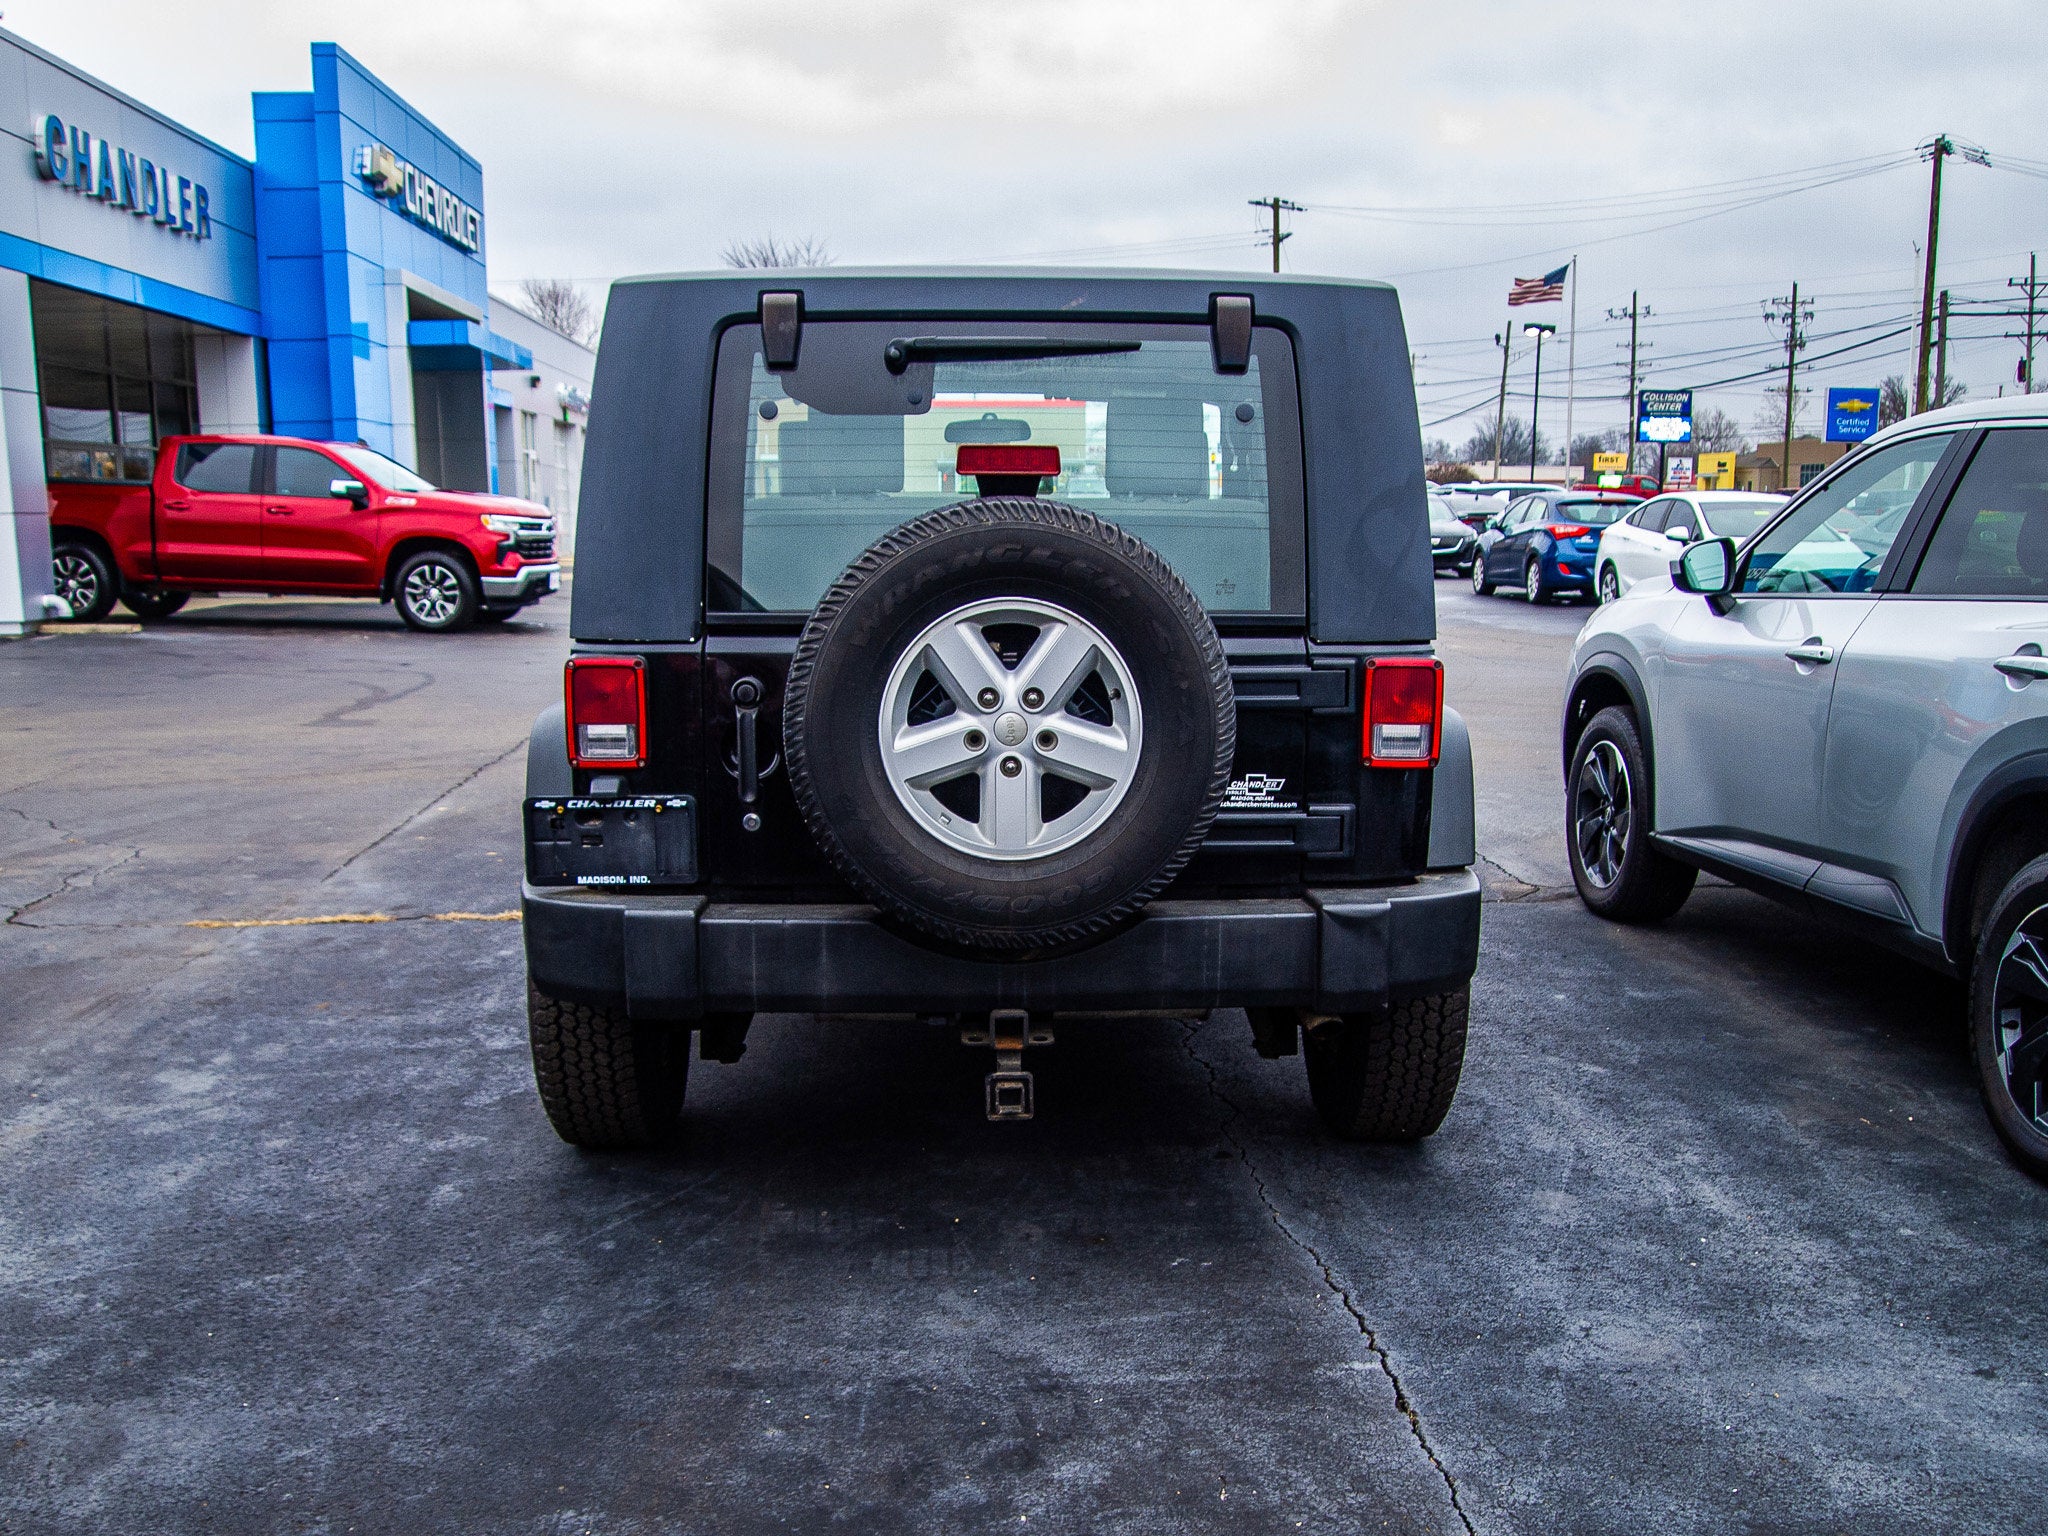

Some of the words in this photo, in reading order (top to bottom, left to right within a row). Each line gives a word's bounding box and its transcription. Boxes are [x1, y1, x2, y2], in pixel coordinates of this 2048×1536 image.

[37, 113, 213, 240] CHANDLER
[403, 161, 482, 254] CHEVROLET
[1642, 392, 1689, 402] COLLISION
[1646, 402, 1682, 411] CENTER
[1839, 425, 1867, 433] Service
[1231, 780, 1277, 788] CHANDLER
[629, 875, 651, 884] IND.
